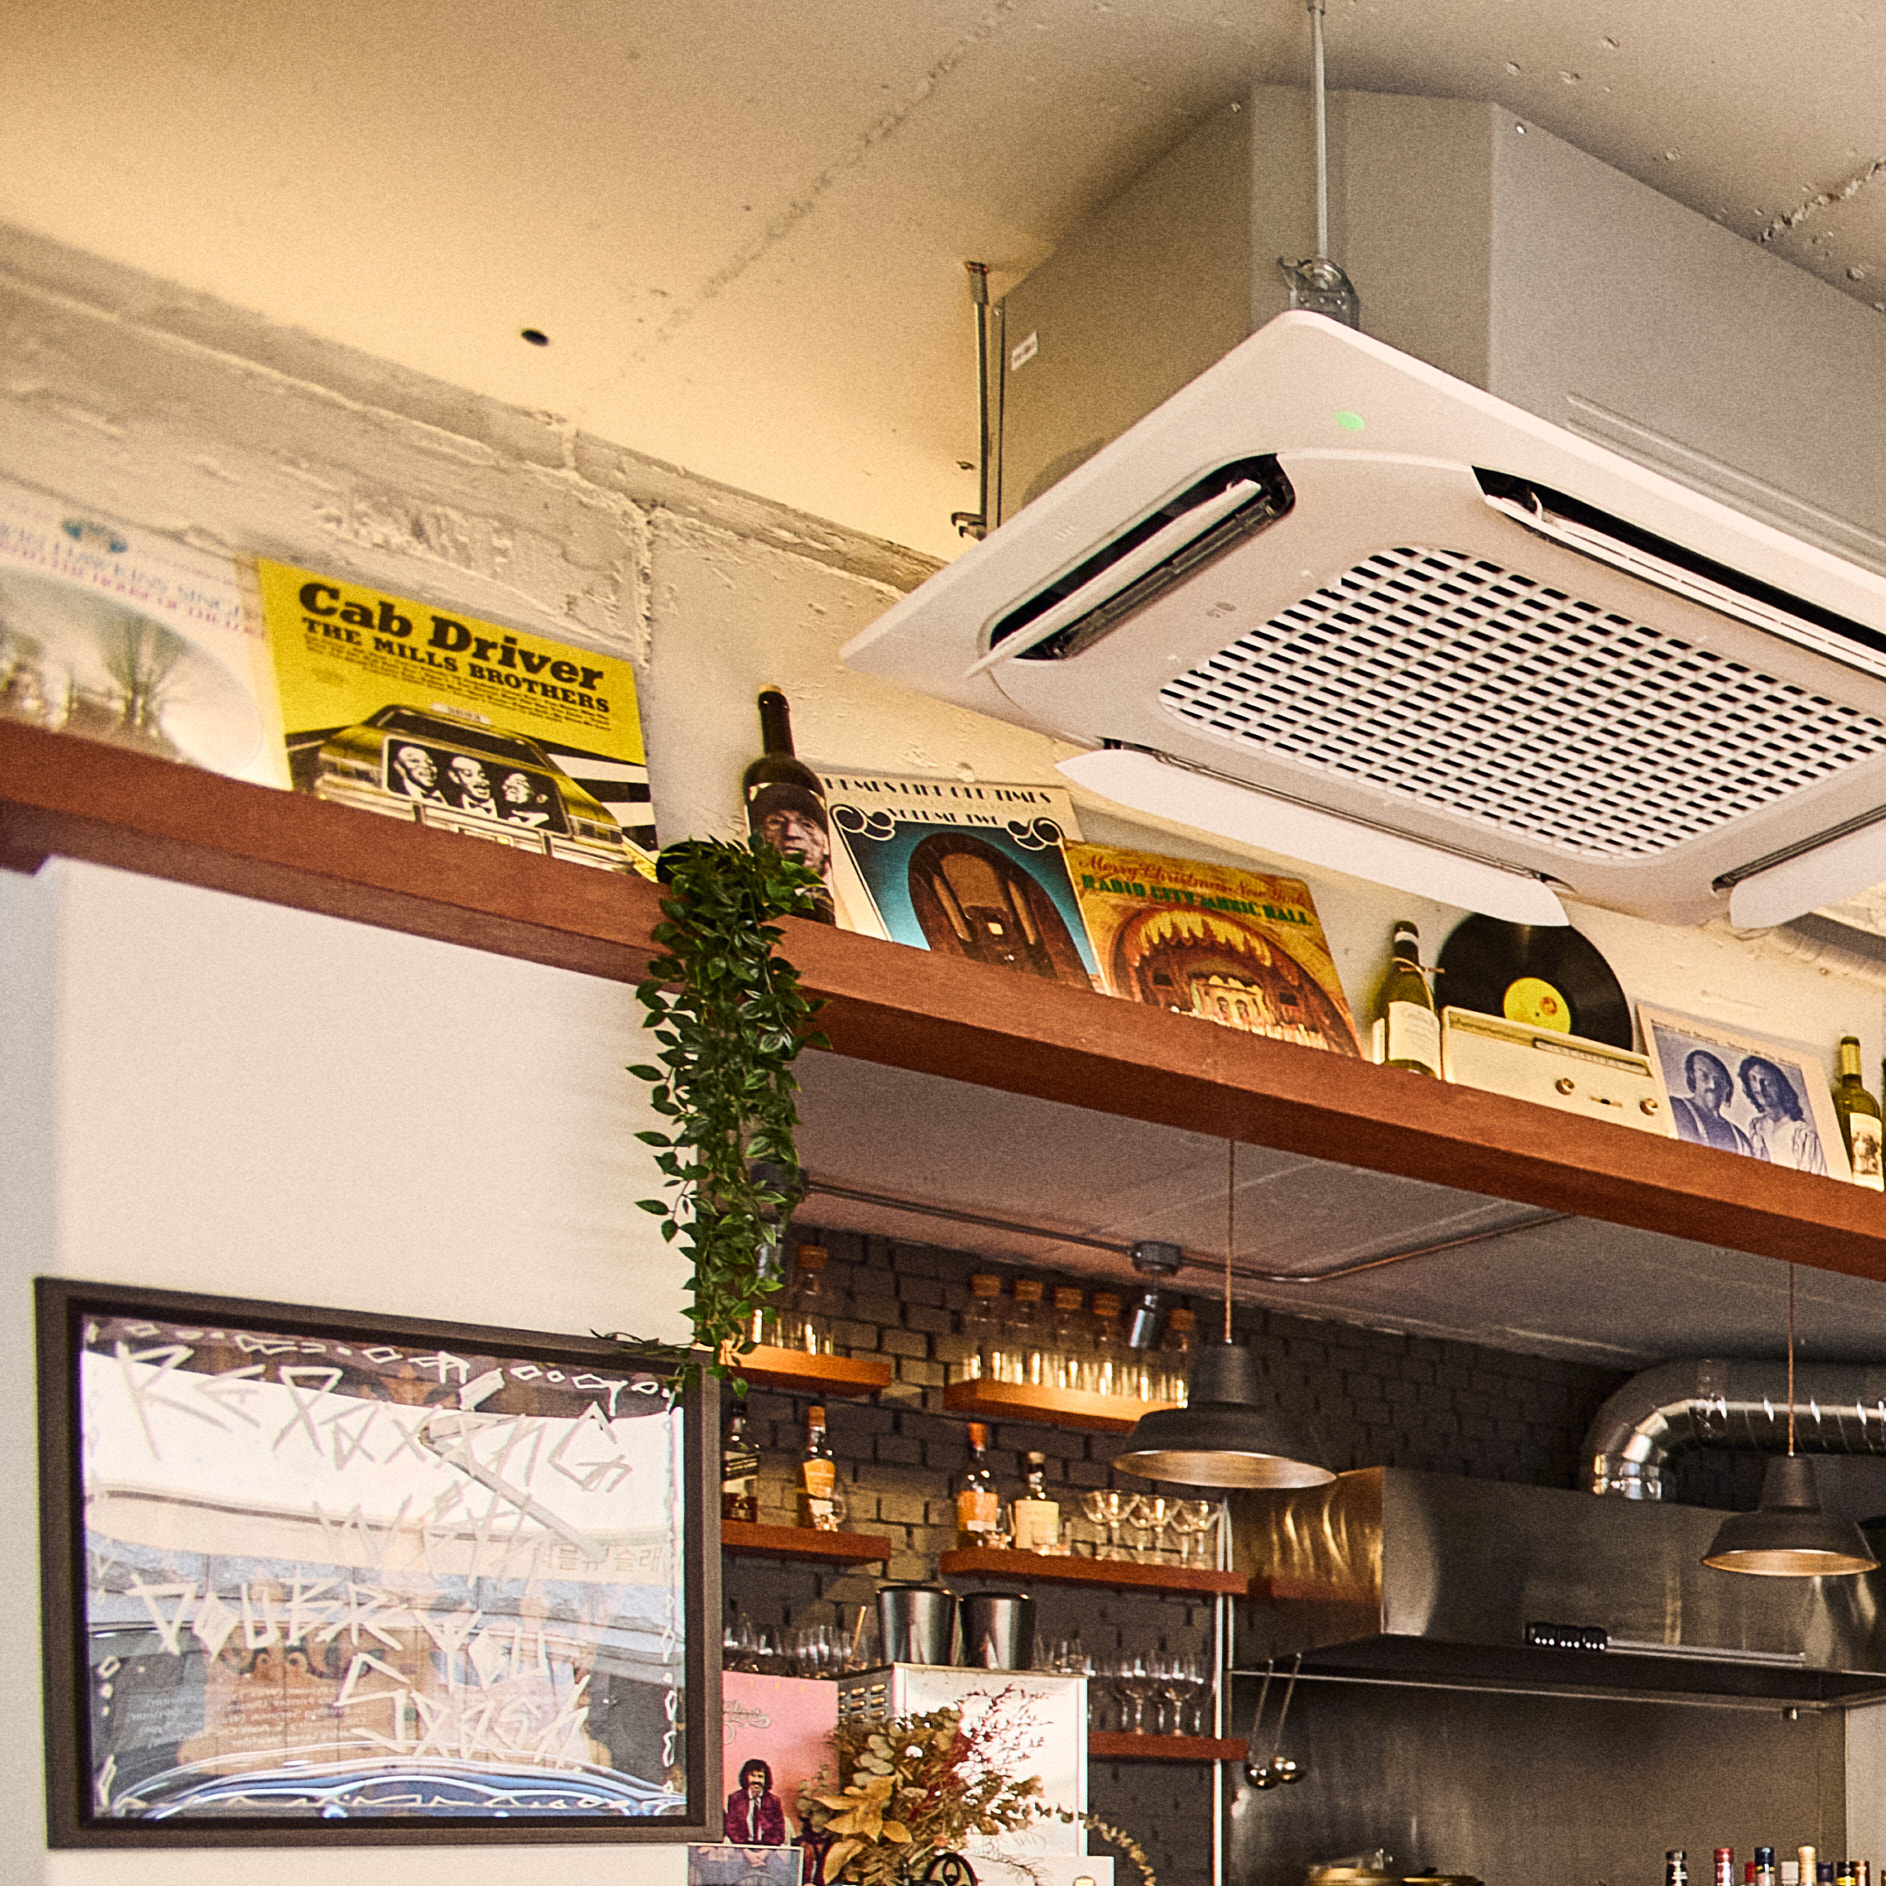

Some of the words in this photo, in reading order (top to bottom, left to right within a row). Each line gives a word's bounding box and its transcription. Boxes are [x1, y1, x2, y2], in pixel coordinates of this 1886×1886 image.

[299, 583, 413, 638] Cab
[428, 615, 604, 691] Driver
[302, 617, 362, 646] THE
[374, 637, 458, 672] MILLS
[469, 662, 610, 713] BROTHERS
[995, 789, 1052, 804] TIMES
[1081, 873, 1146, 897] RADIO
[1150, 886, 1195, 905] CITY
[1262, 904, 1312, 926] HALL
